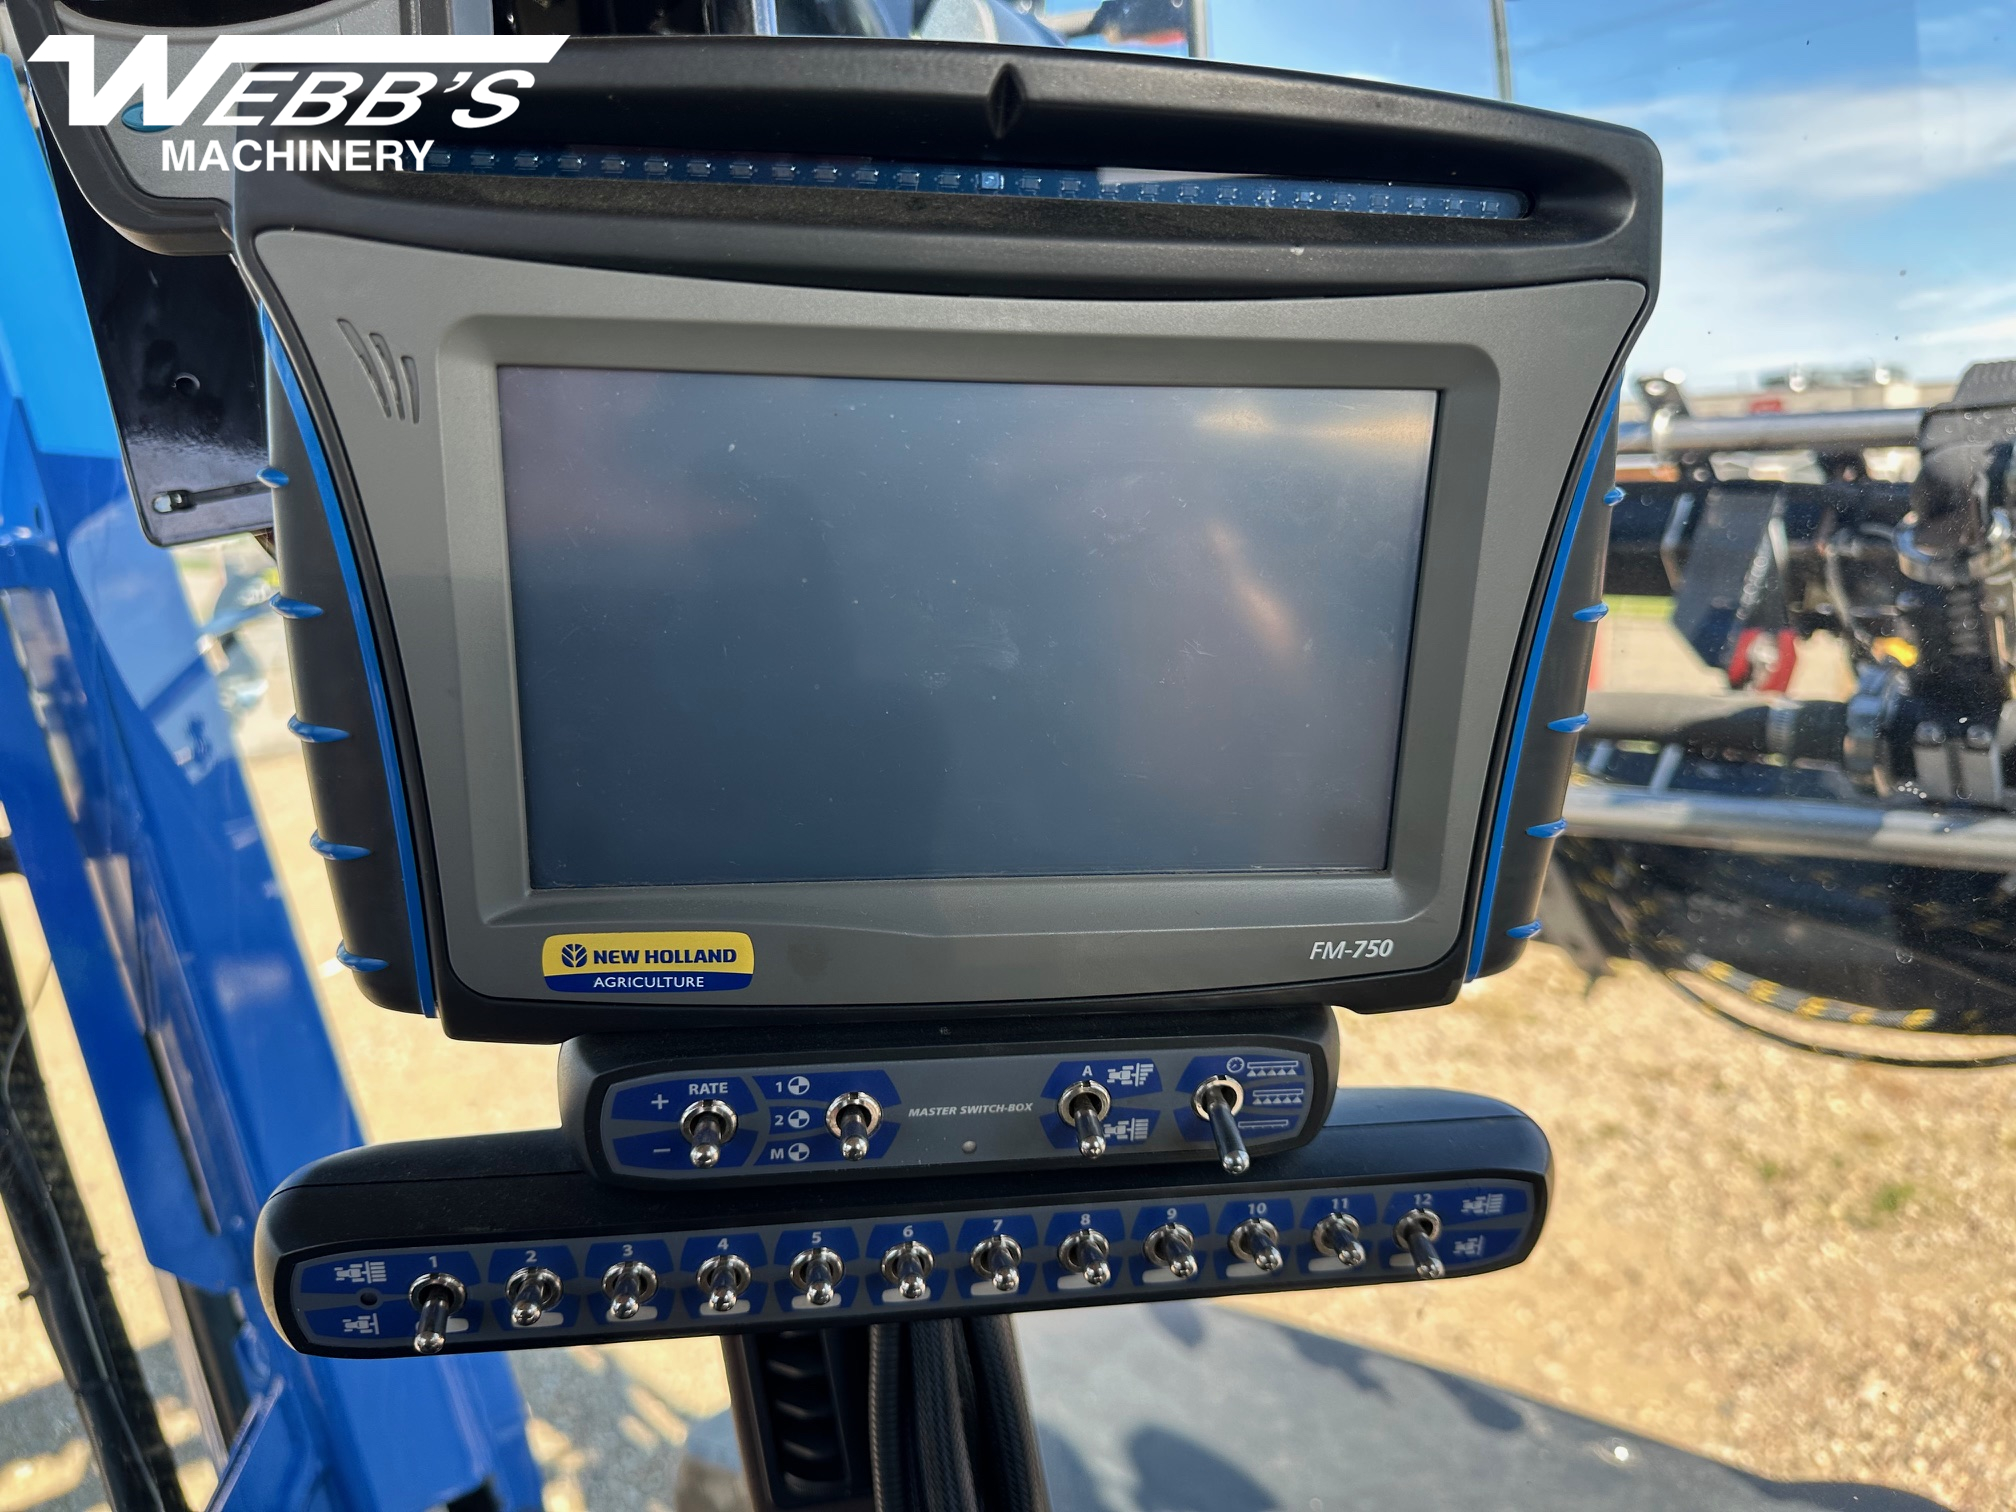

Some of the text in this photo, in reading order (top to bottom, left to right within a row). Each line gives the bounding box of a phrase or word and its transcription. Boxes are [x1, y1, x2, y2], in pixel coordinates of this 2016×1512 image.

[593, 948, 737, 964] NEW HOLLAND
[1309, 939, 1394, 960] FM-750
[593, 976, 704, 988] AGRICULTURE
[1082, 1065, 1094, 1077] A
[688, 1082, 728, 1096] RATE
[774, 1081, 783, 1093] 1
[908, 1102, 1034, 1118] MASTER SWITCH-BOX
[774, 1114, 784, 1126] 2
[770, 1148, 784, 1160] M
[429, 1192, 1432, 1268] 1 2 3 4 5 6 7 8 9 10 11 12
